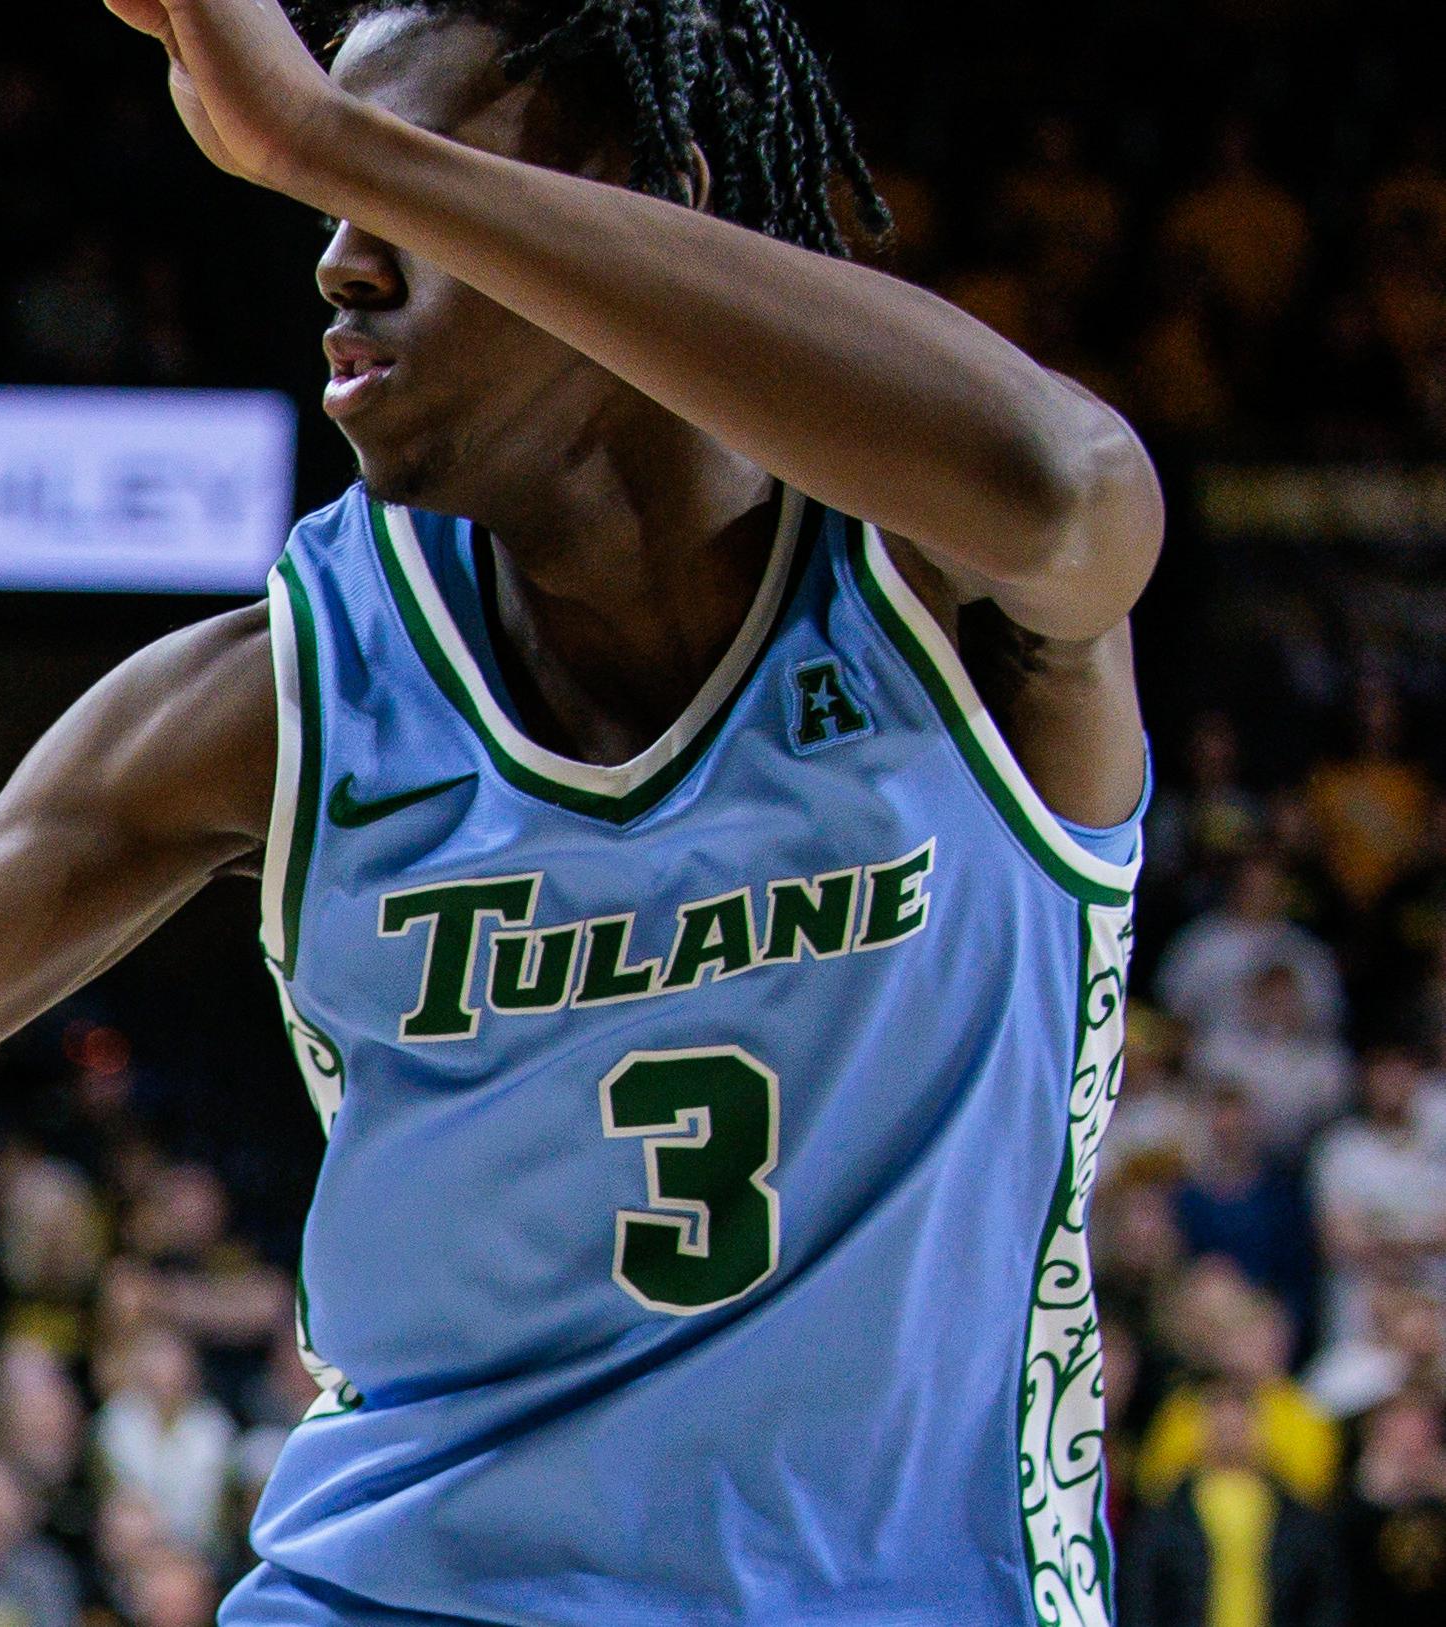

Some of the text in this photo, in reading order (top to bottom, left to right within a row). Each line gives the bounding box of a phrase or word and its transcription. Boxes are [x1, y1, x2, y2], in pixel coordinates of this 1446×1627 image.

[795, 662, 869, 745] A
[377, 836, 937, 1043] TULANE
[598, 1044, 779, 1316] 3
